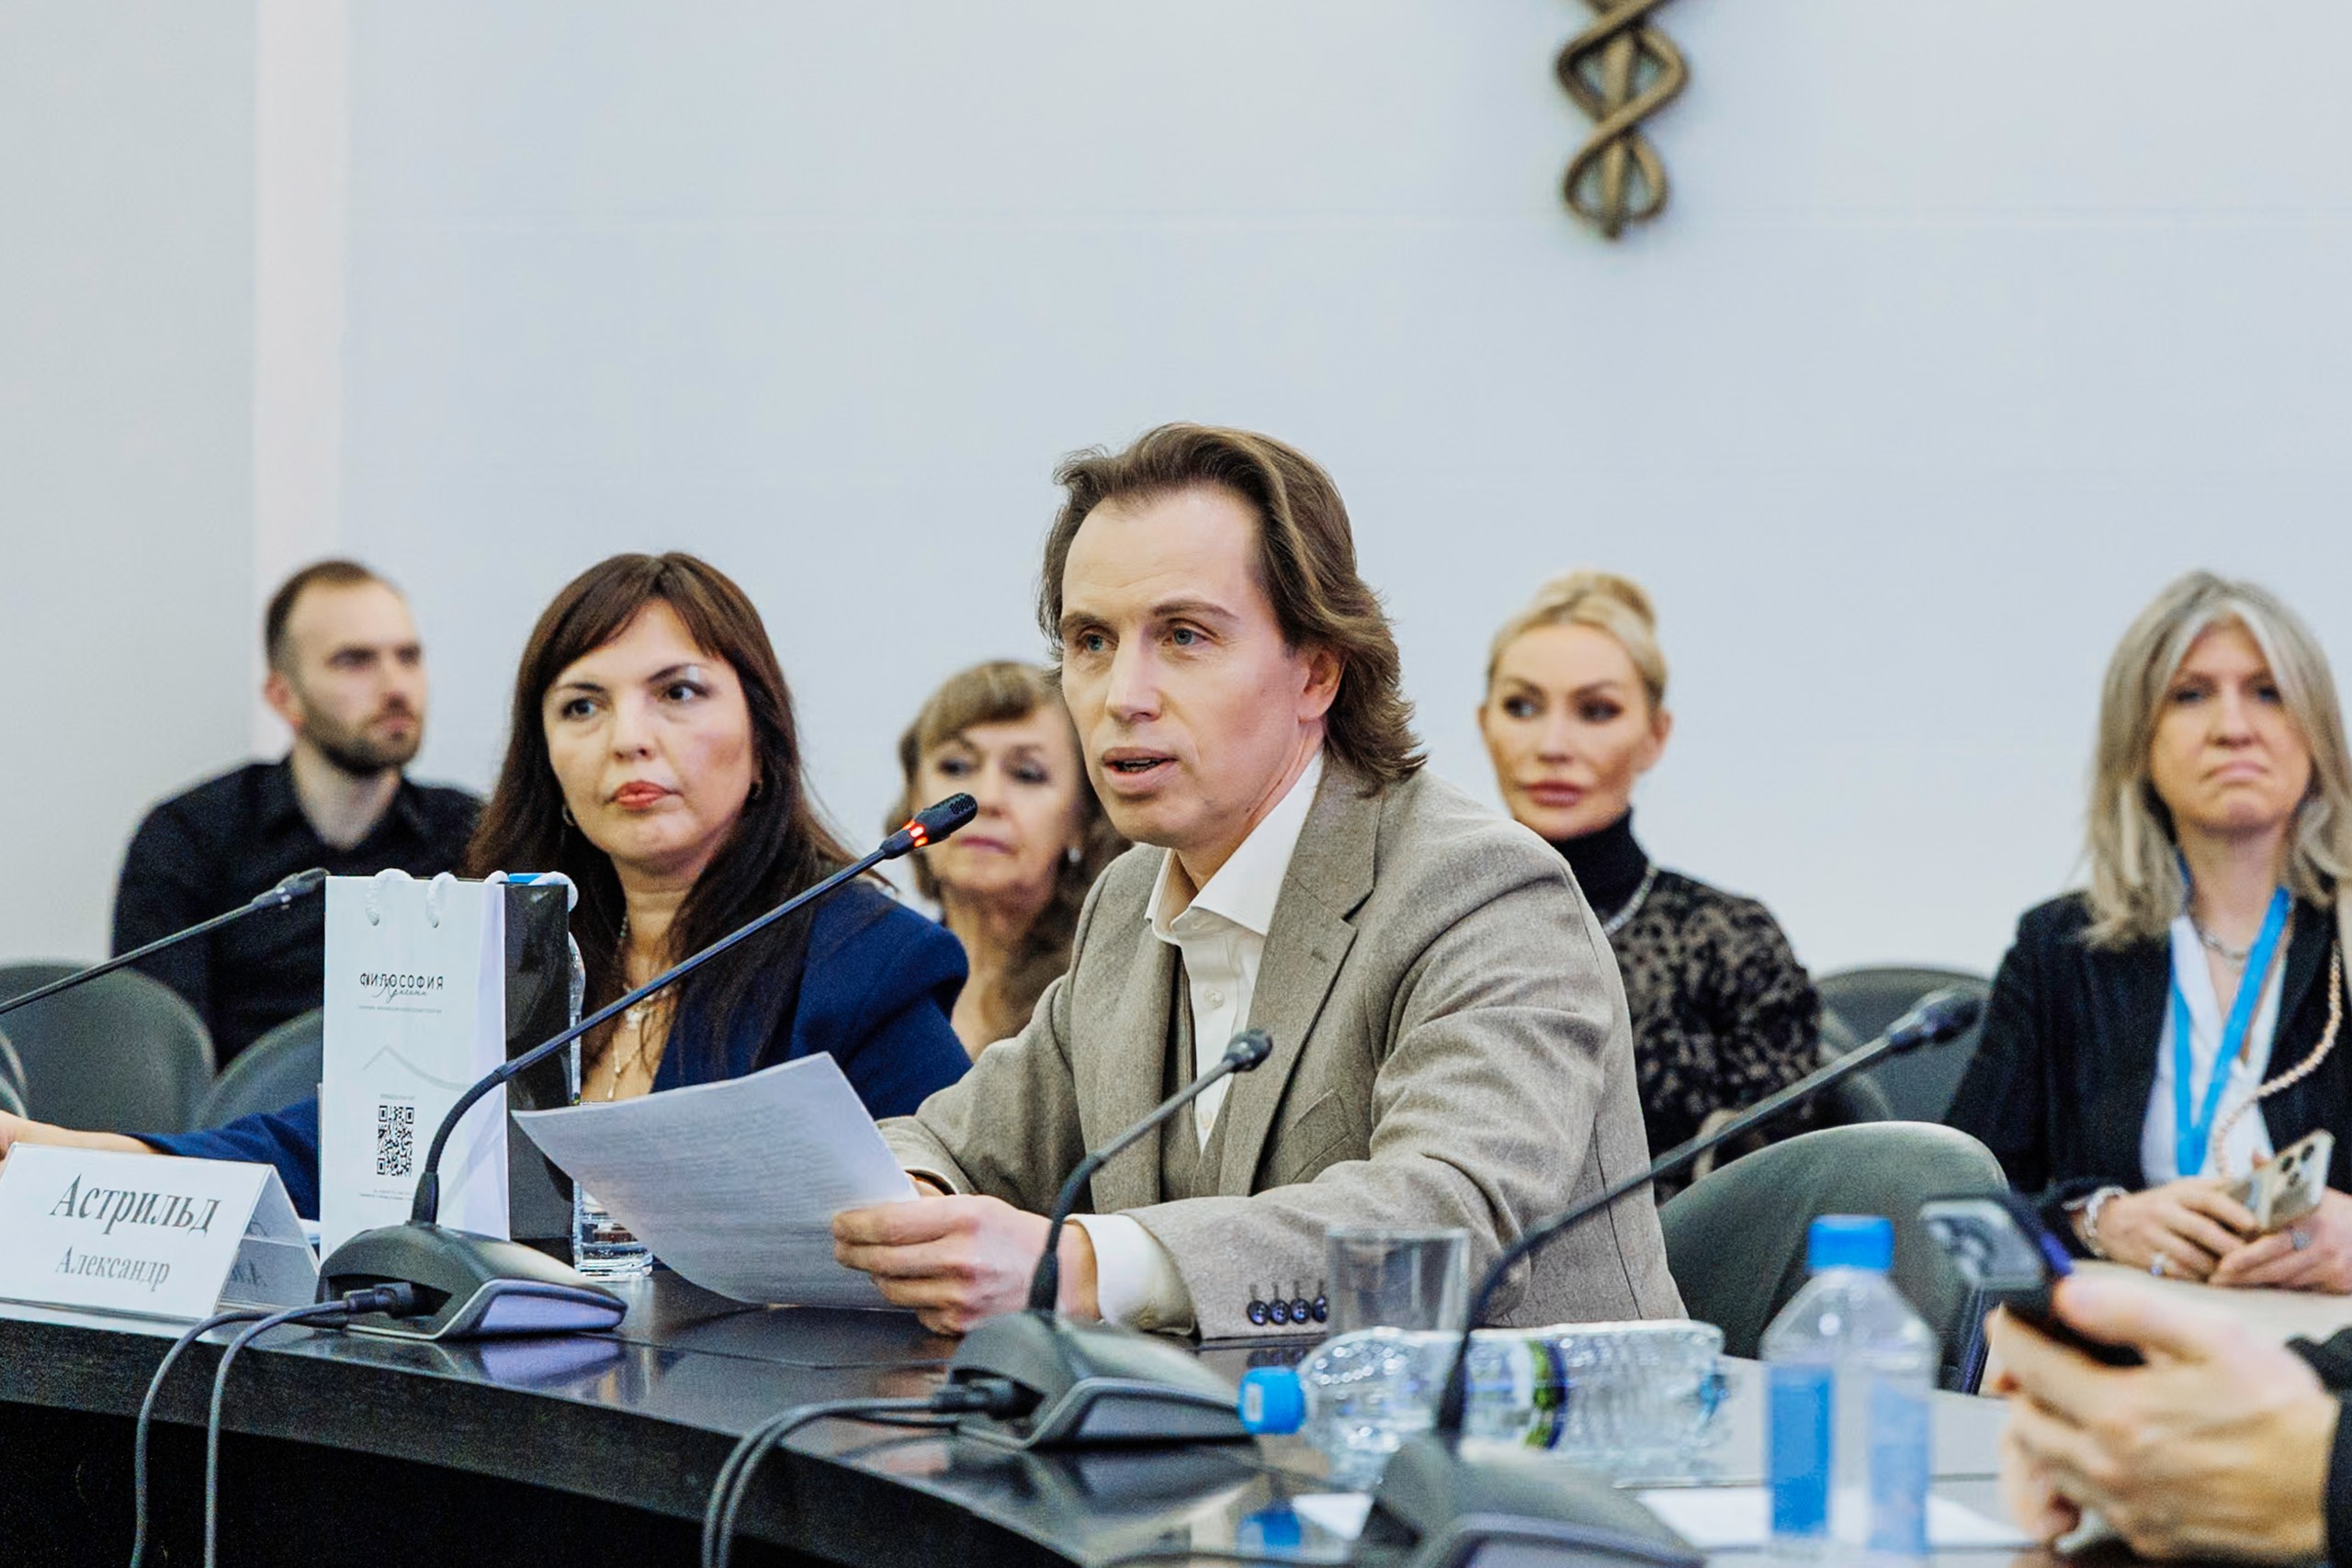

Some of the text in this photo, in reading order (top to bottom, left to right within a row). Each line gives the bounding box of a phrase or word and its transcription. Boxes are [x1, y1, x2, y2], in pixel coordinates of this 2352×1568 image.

[359, 972, 444, 989] ФИЛОСОФИЯ
[49, 1173, 221, 1235] Астрильд
[55, 1246, 171, 1292] Александр
